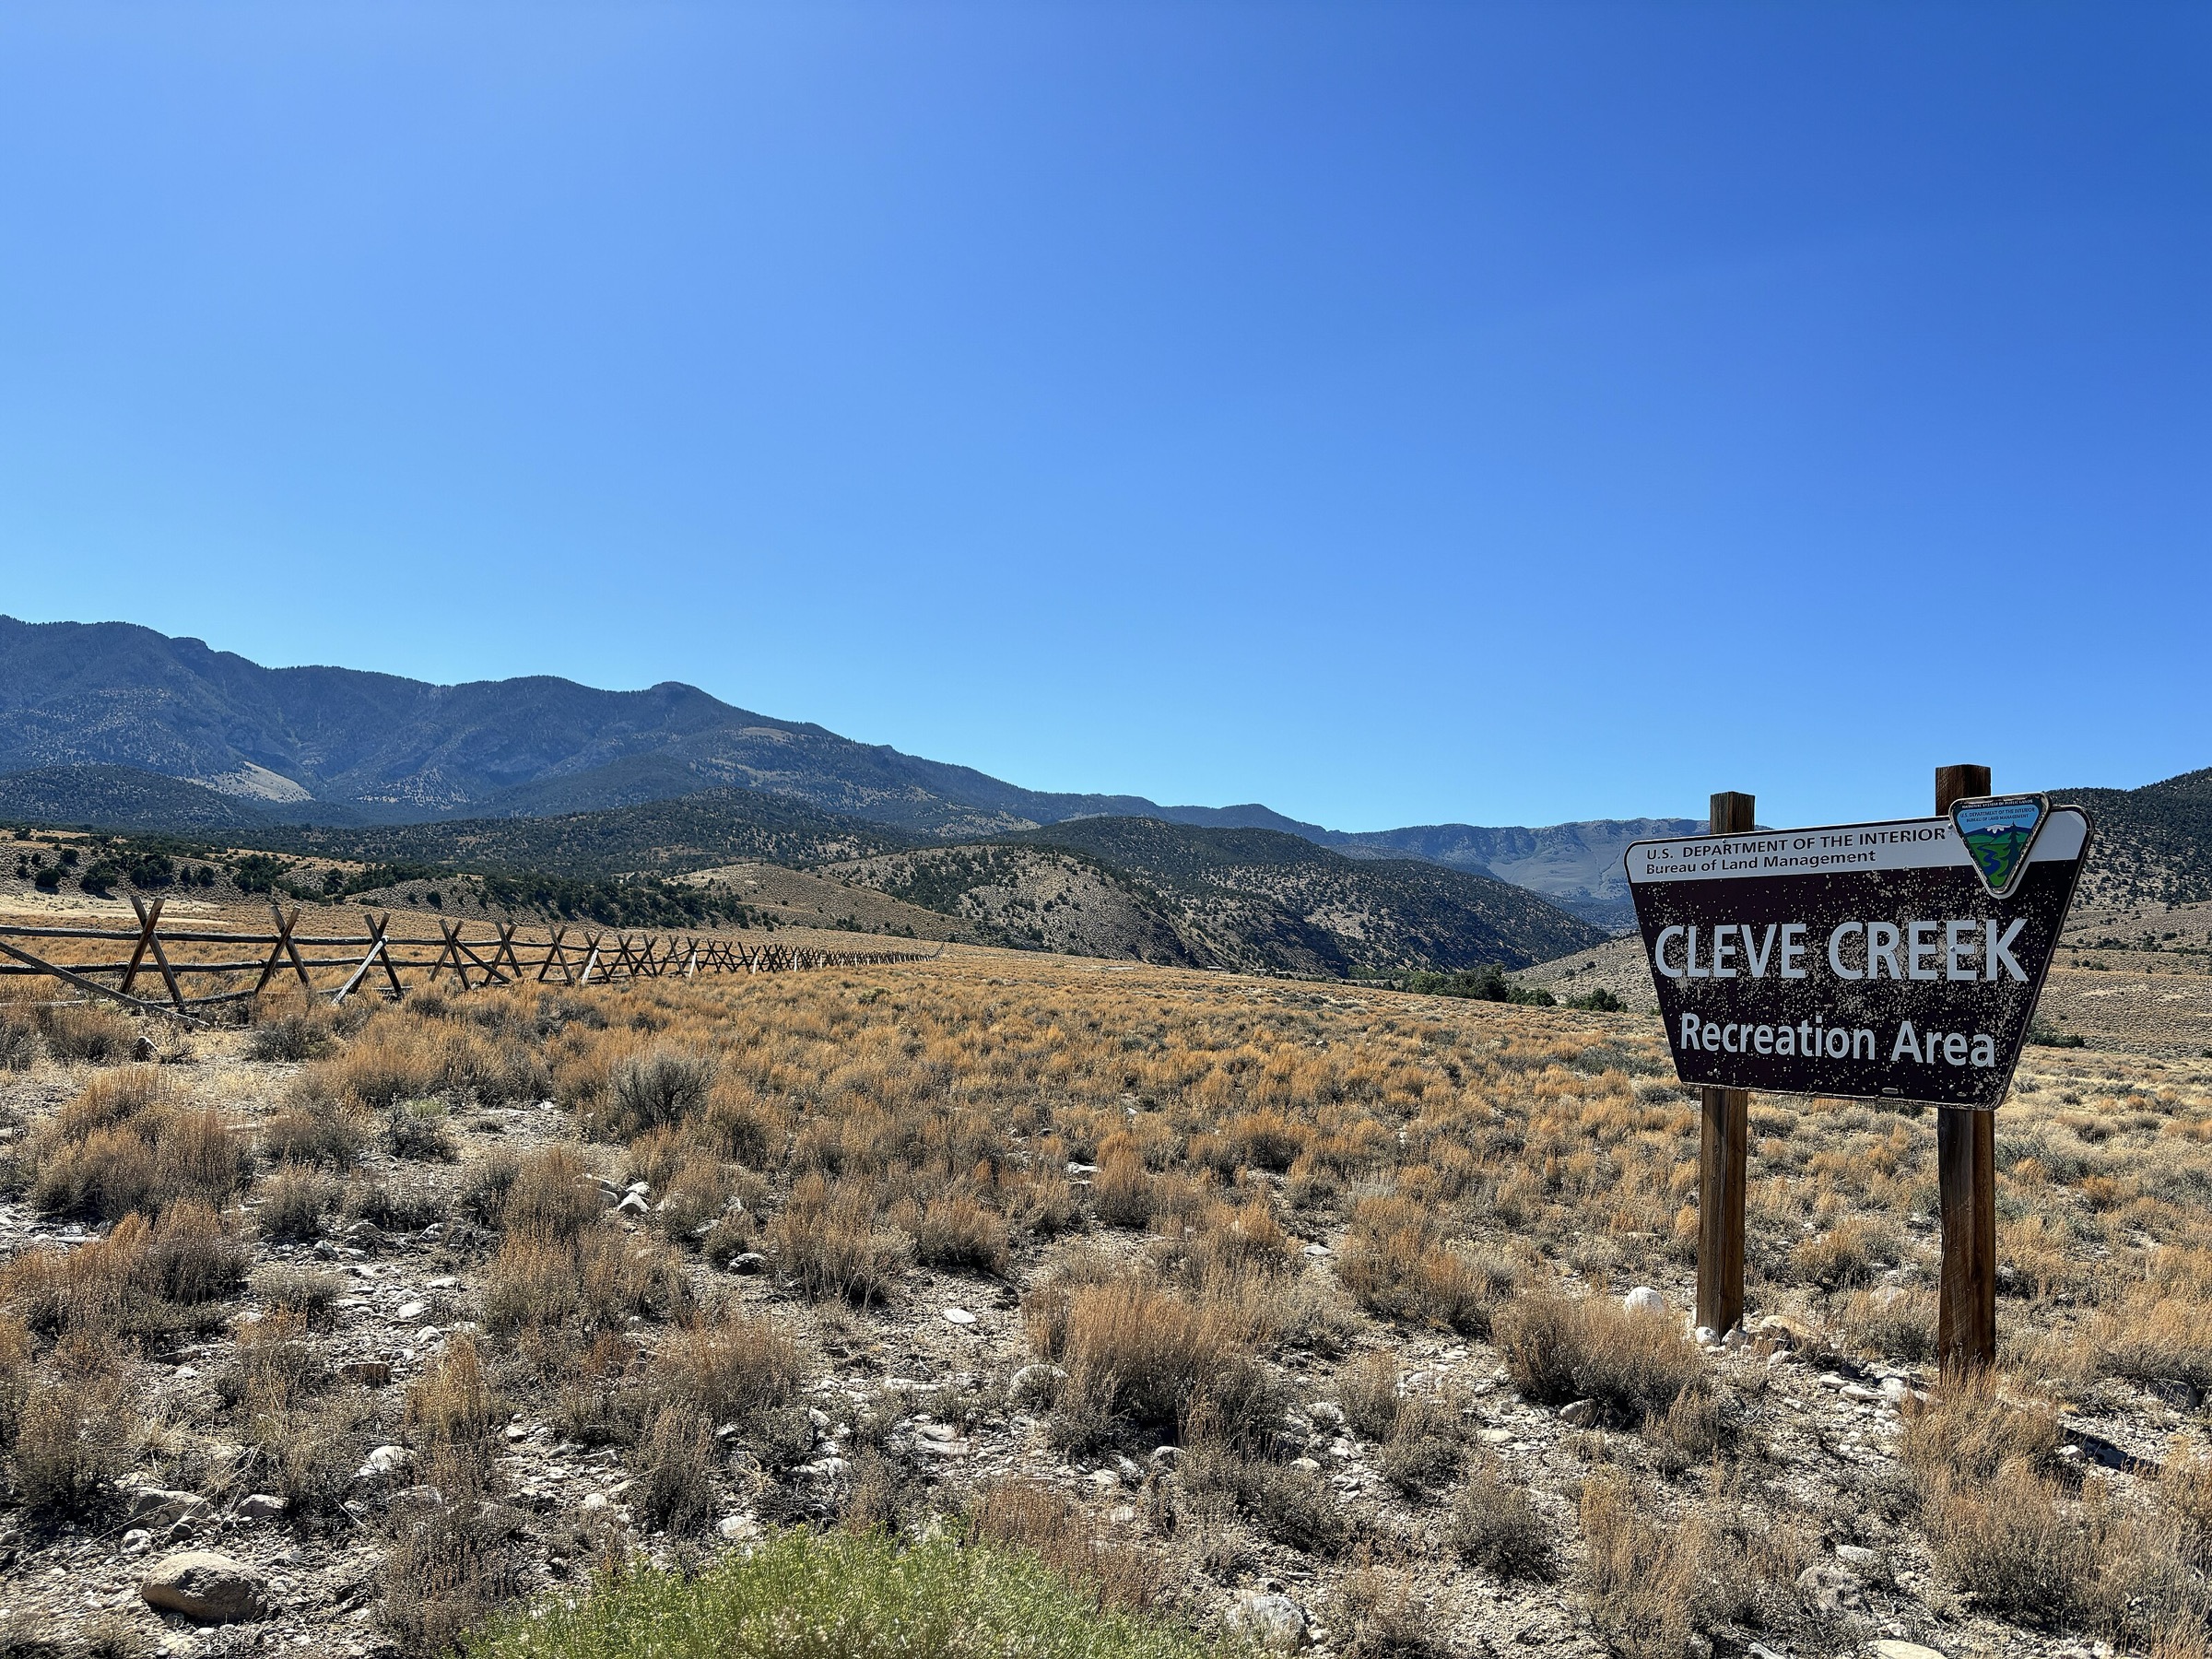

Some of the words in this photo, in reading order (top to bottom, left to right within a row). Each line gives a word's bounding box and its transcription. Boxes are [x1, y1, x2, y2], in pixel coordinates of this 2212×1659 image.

[1646, 848, 1674, 860] U.S.
[1683, 840, 1789, 858] DEPARTMENT
[1793, 837, 1816, 850] OF
[1819, 834, 1853, 848] THE
[1859, 828, 1946, 845] INTERIOR
[1646, 863, 1696, 875] Bureau
[1701, 859, 1717, 872] of
[1722, 857, 1758, 870] Land
[1763, 850, 1876, 868] Management
[1655, 923, 1806, 978] CLEVE
[1828, 918, 2029, 982] CREEK
[1680, 1012, 1876, 1060] Recreation
[1890, 1019, 1995, 1067] Area
